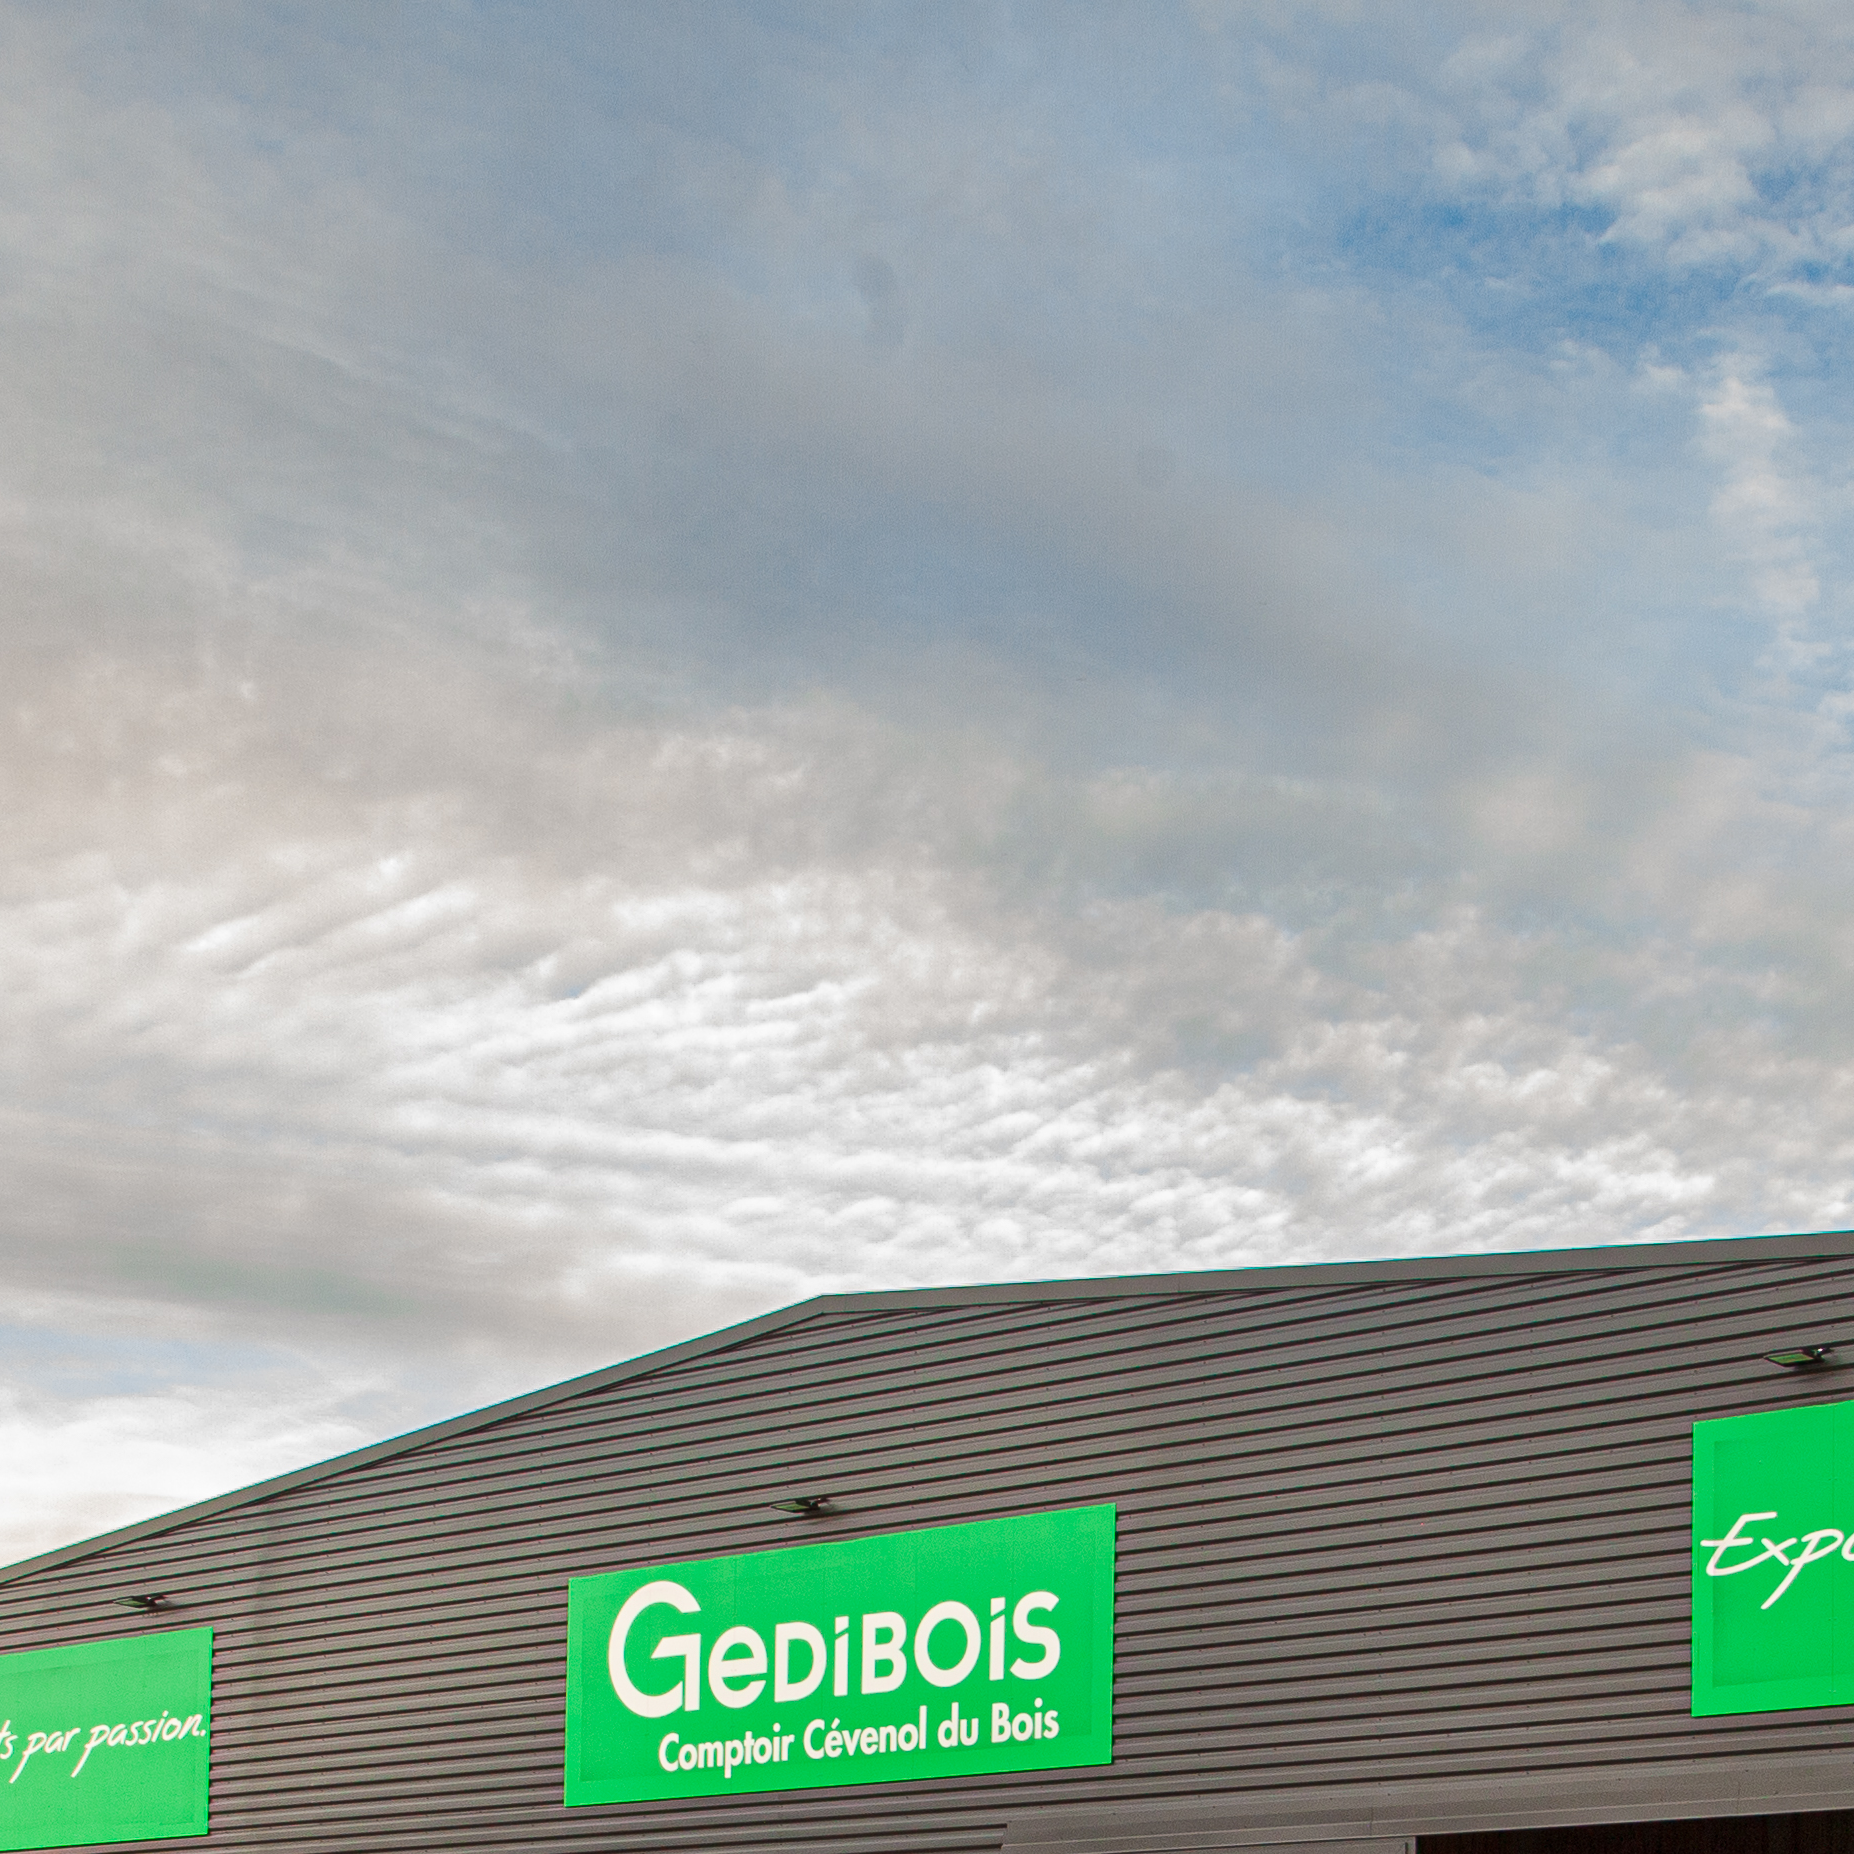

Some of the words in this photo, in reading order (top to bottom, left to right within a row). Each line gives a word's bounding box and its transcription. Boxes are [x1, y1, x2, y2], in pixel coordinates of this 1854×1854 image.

[9, 1728, 80, 1783] par
[71, 1710, 206, 1777] passion.
[658, 1723, 795, 1778] Comptoir
[803, 1706, 927, 1760] Cévenol
[937, 1702, 979, 1748] du
[991, 1698, 1060, 1743] Bois
